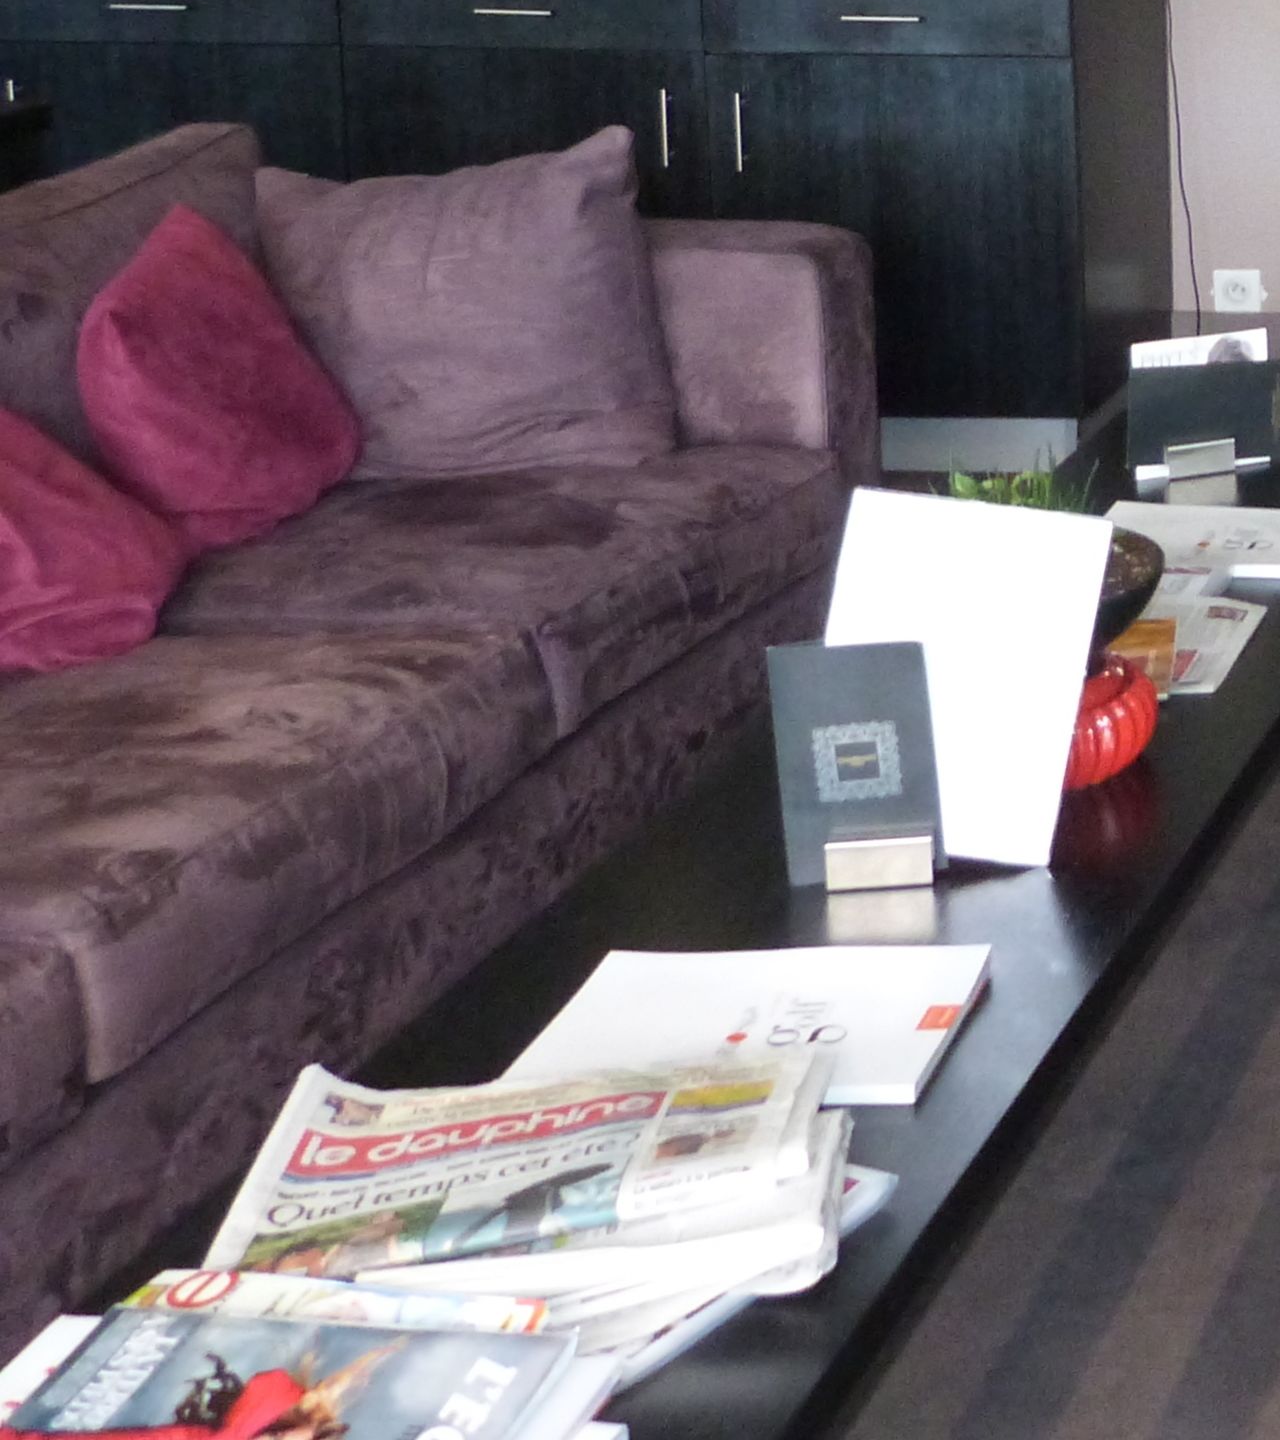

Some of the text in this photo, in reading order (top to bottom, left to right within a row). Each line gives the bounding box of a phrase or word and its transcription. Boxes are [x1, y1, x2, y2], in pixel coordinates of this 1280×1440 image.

[300, 1135, 357, 1166] le
[267, 1192, 365, 1228] Quel
[372, 1169, 489, 1205] temps
